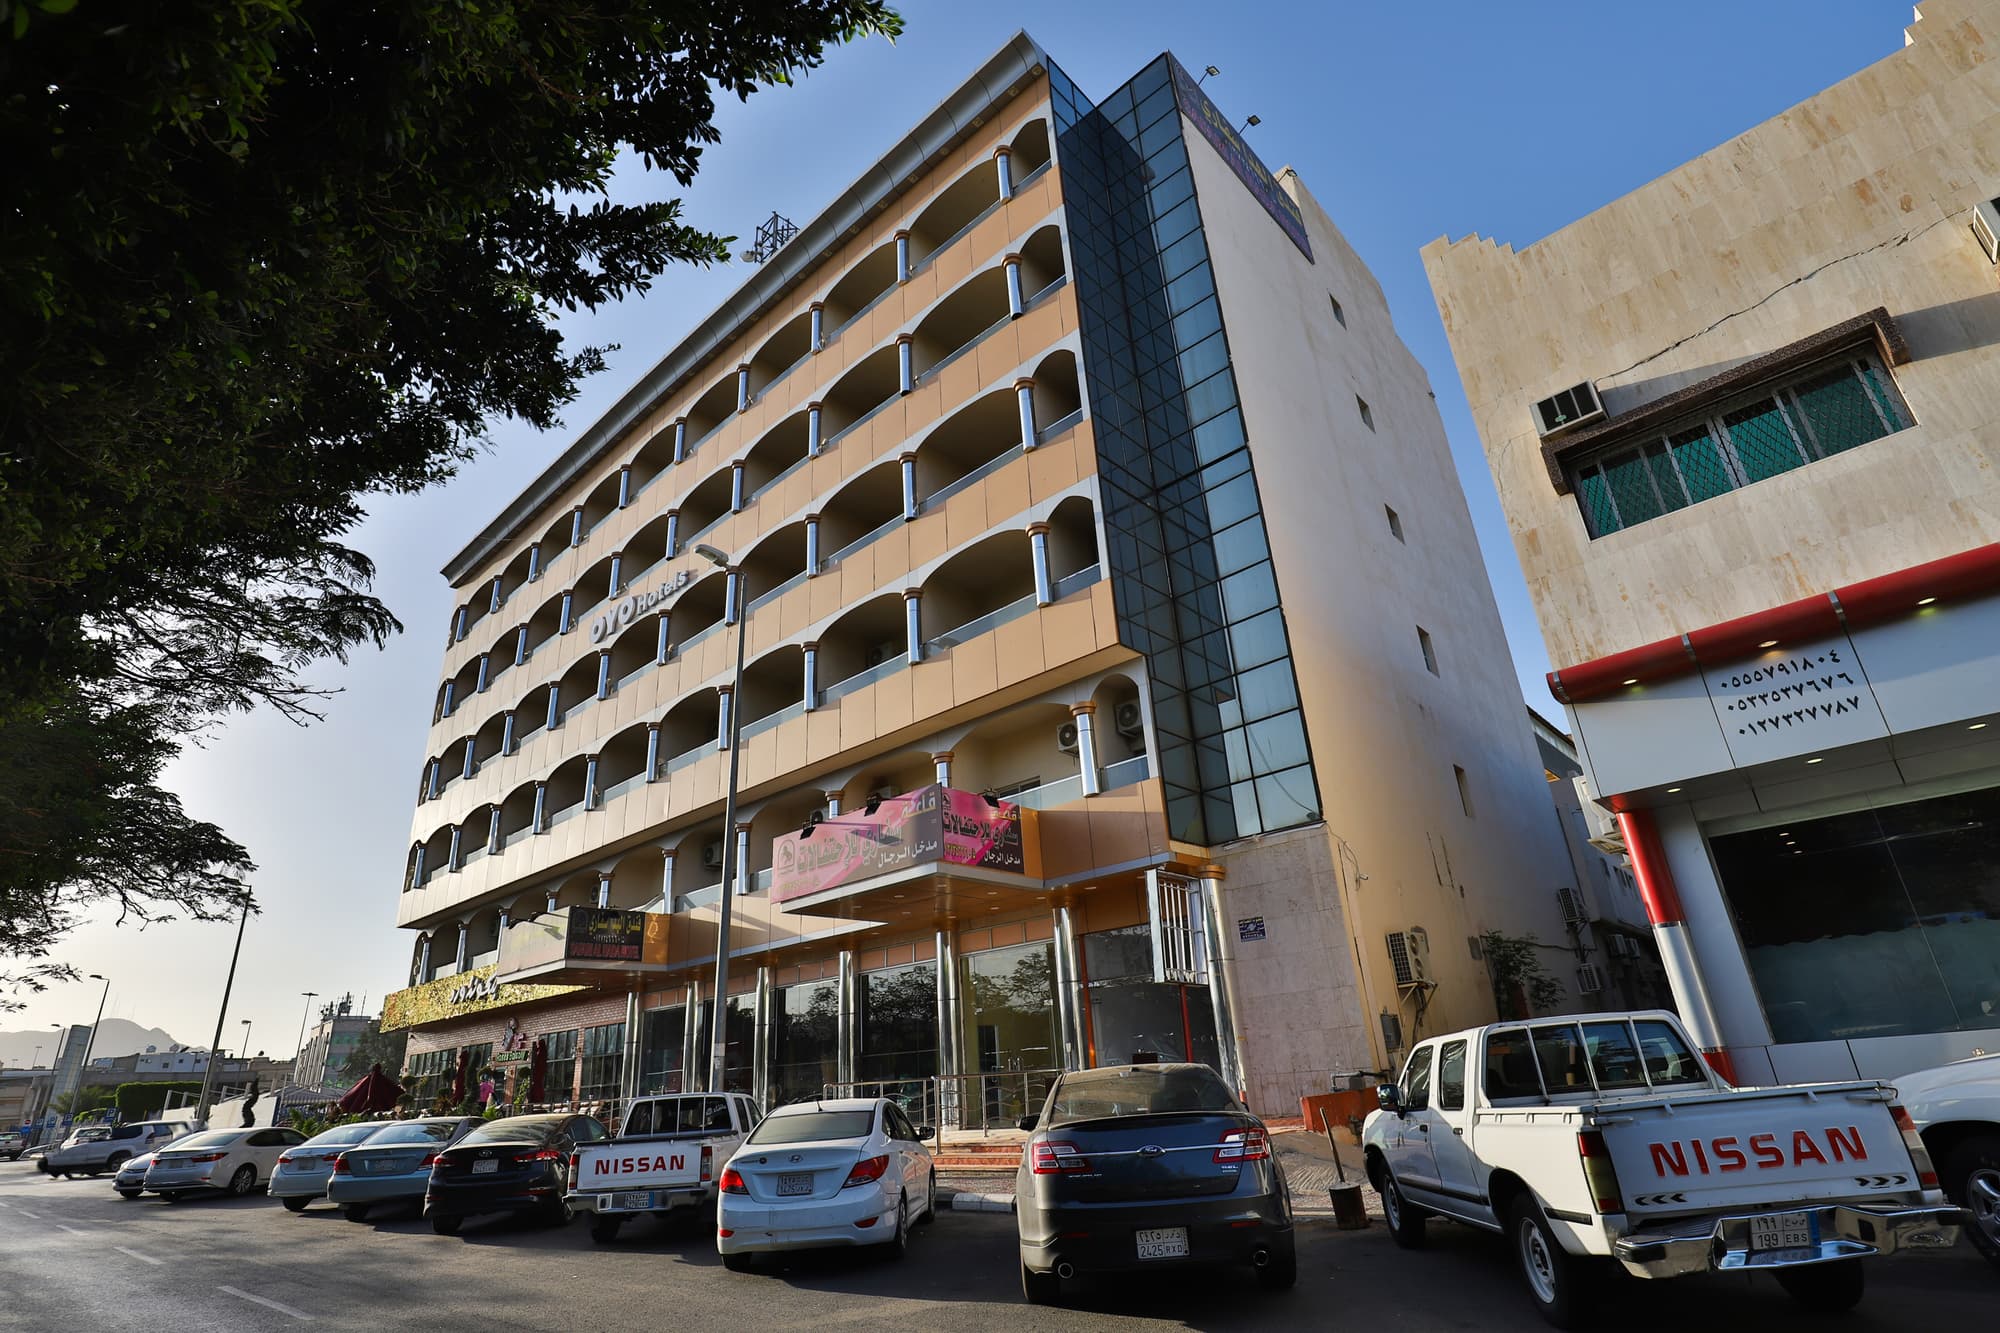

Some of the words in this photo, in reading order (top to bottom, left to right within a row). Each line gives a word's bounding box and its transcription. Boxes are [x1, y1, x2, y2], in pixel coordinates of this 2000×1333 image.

[591, 596, 636, 644] OYO
[637, 571, 688, 614] Hotels
[1721, 649, 1841, 688] ٠٥٥٥٧٩١٨٠٤
[1727, 672, 1854, 711] ٠٥٣٣٥٣٧٦٧٦
[1739, 695, 1859, 735] ٠١٢٧٣٢٧٧٨٧
[878, 846, 911, 868] الرجال
[911, 839, 938, 858] مدخل
[594, 1154, 685, 1176] NISSAN
[1648, 1125, 1869, 1178] NISSAN
[1140, 1245, 1163, 1257] 2425
[1758, 1233, 1779, 1247] 199
[1785, 1233, 1808, 1243] EBS
